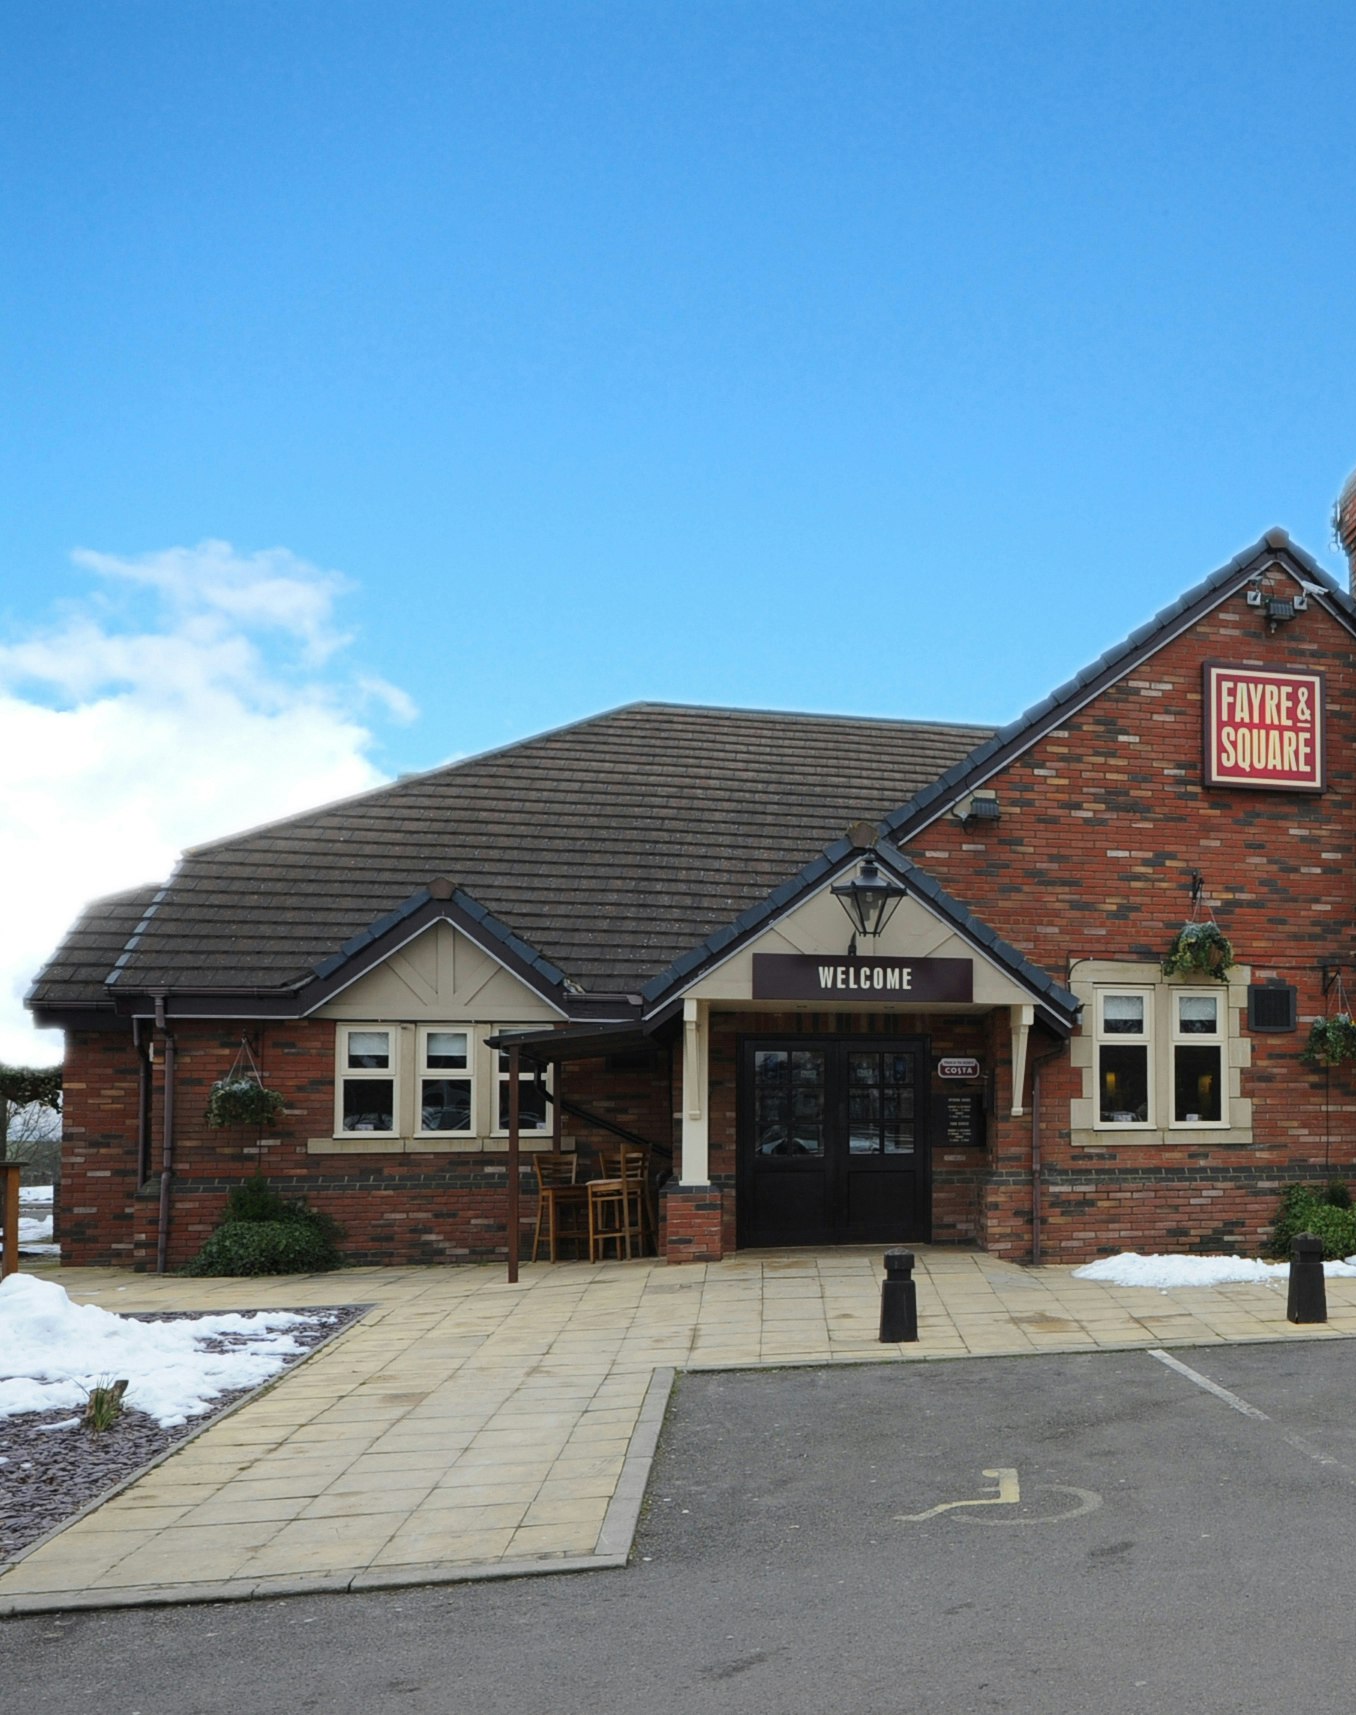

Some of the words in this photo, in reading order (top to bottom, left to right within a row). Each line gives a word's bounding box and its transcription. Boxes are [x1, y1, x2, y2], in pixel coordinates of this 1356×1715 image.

[1221, 680, 1293, 726] FAYRE
[1296, 686, 1312, 728] &
[1221, 726, 1311, 772] SQUARE
[818, 966, 912, 990] WELCOME
[944, 1067, 973, 1075] COSTA
